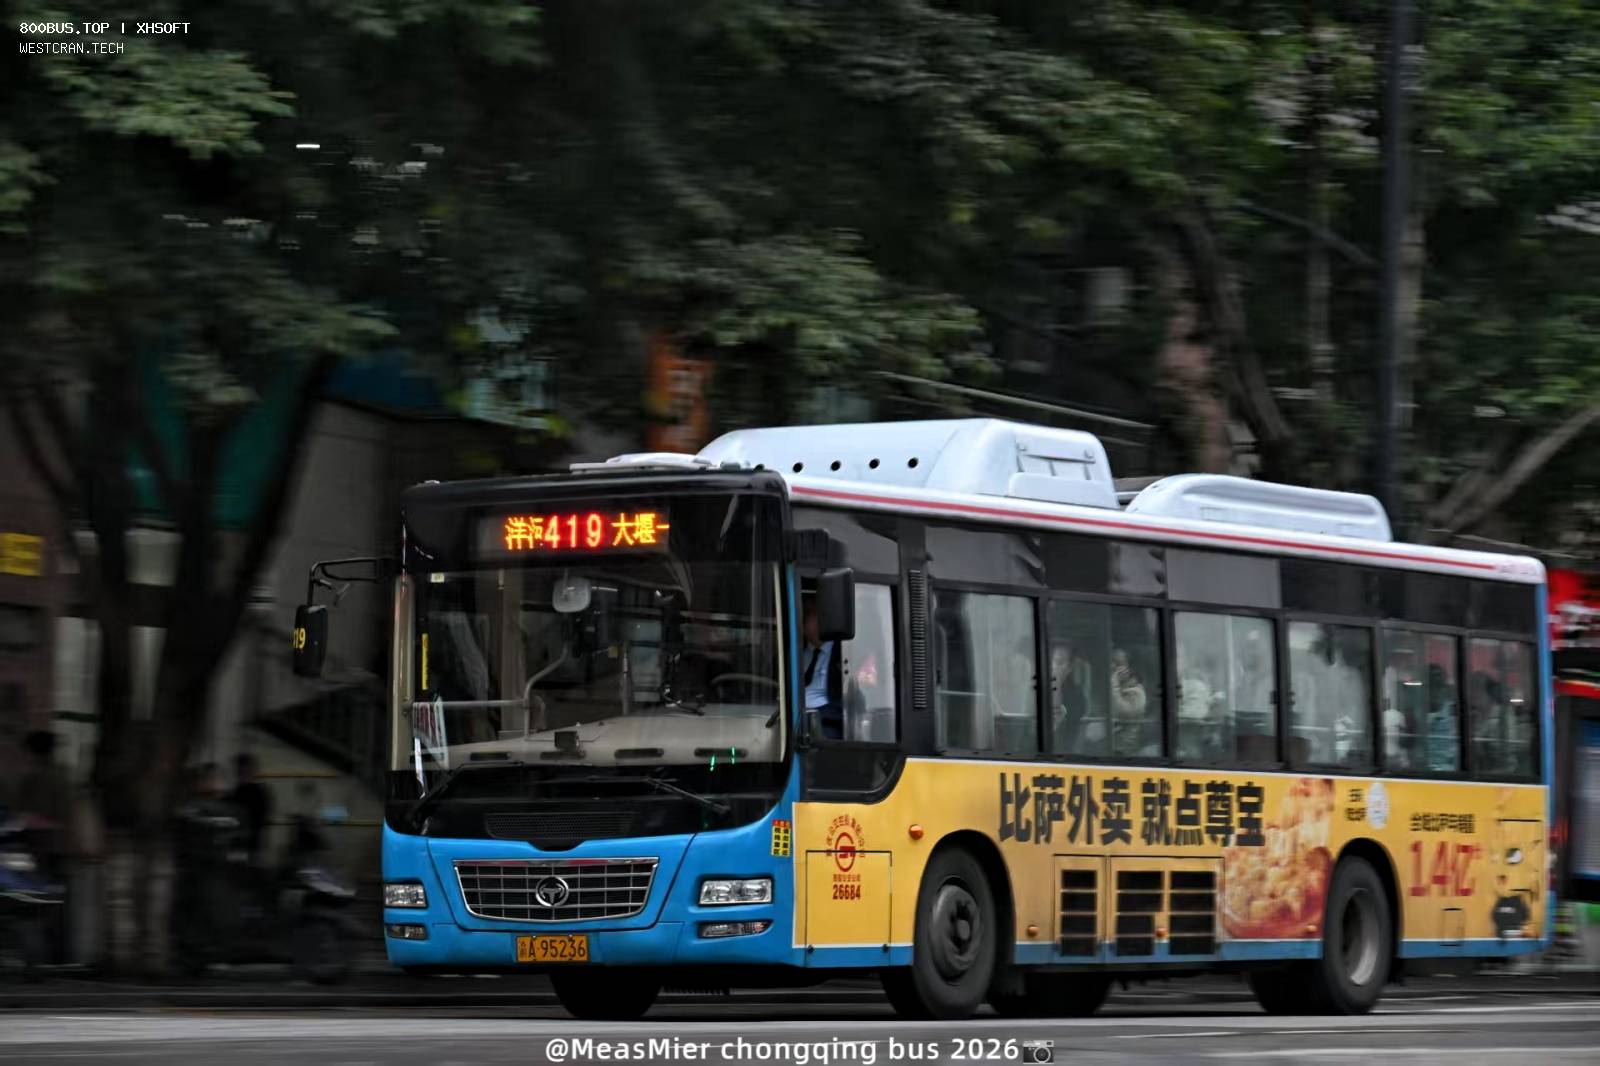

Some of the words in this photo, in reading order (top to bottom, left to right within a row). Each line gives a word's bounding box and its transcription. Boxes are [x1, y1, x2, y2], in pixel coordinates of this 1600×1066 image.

[544, 514, 602, 548] 419
[998, 772, 1133, 845] 比萨外卖
[1140, 777, 1266, 847] 就点尊宝
[832, 884, 861, 900] 26684
